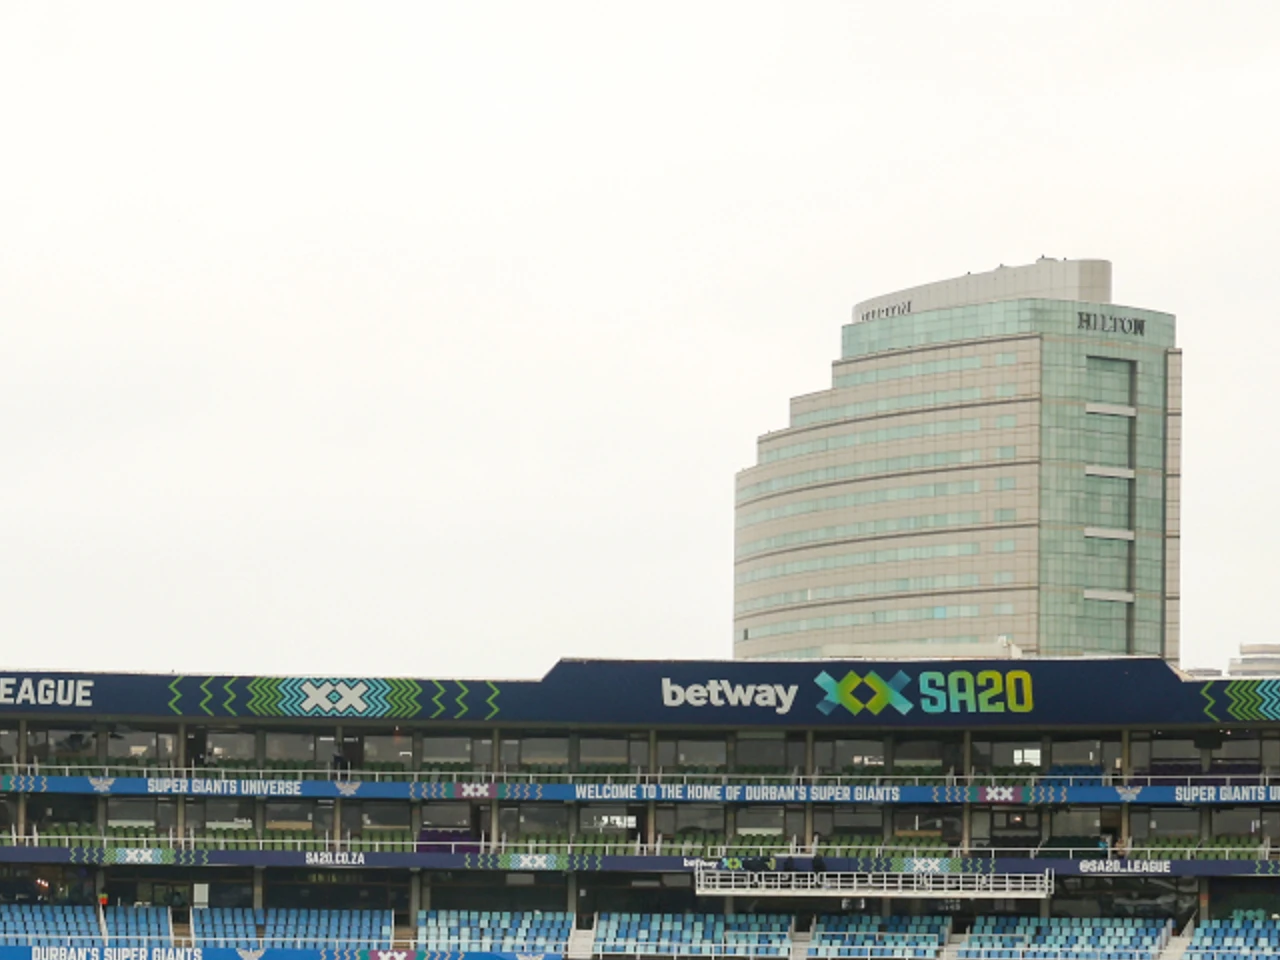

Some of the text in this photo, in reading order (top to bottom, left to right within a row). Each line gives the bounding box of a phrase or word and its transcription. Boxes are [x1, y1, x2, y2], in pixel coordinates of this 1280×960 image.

[1077, 311, 1146, 336] HILTON
[661, 677, 799, 714] betway
[920, 669, 1034, 714] SA20
[147, 777, 302, 797] SUPER GIANTS UNIVERSE
[575, 783, 900, 802] WELCOME TO THE HOME OF DURBAN'S SUPER GIANTS
[1175, 786, 1217, 802] SUPER
[1220, 786, 1266, 803] GIANTS
[306, 851, 365, 866] SA20.CO.ZA
